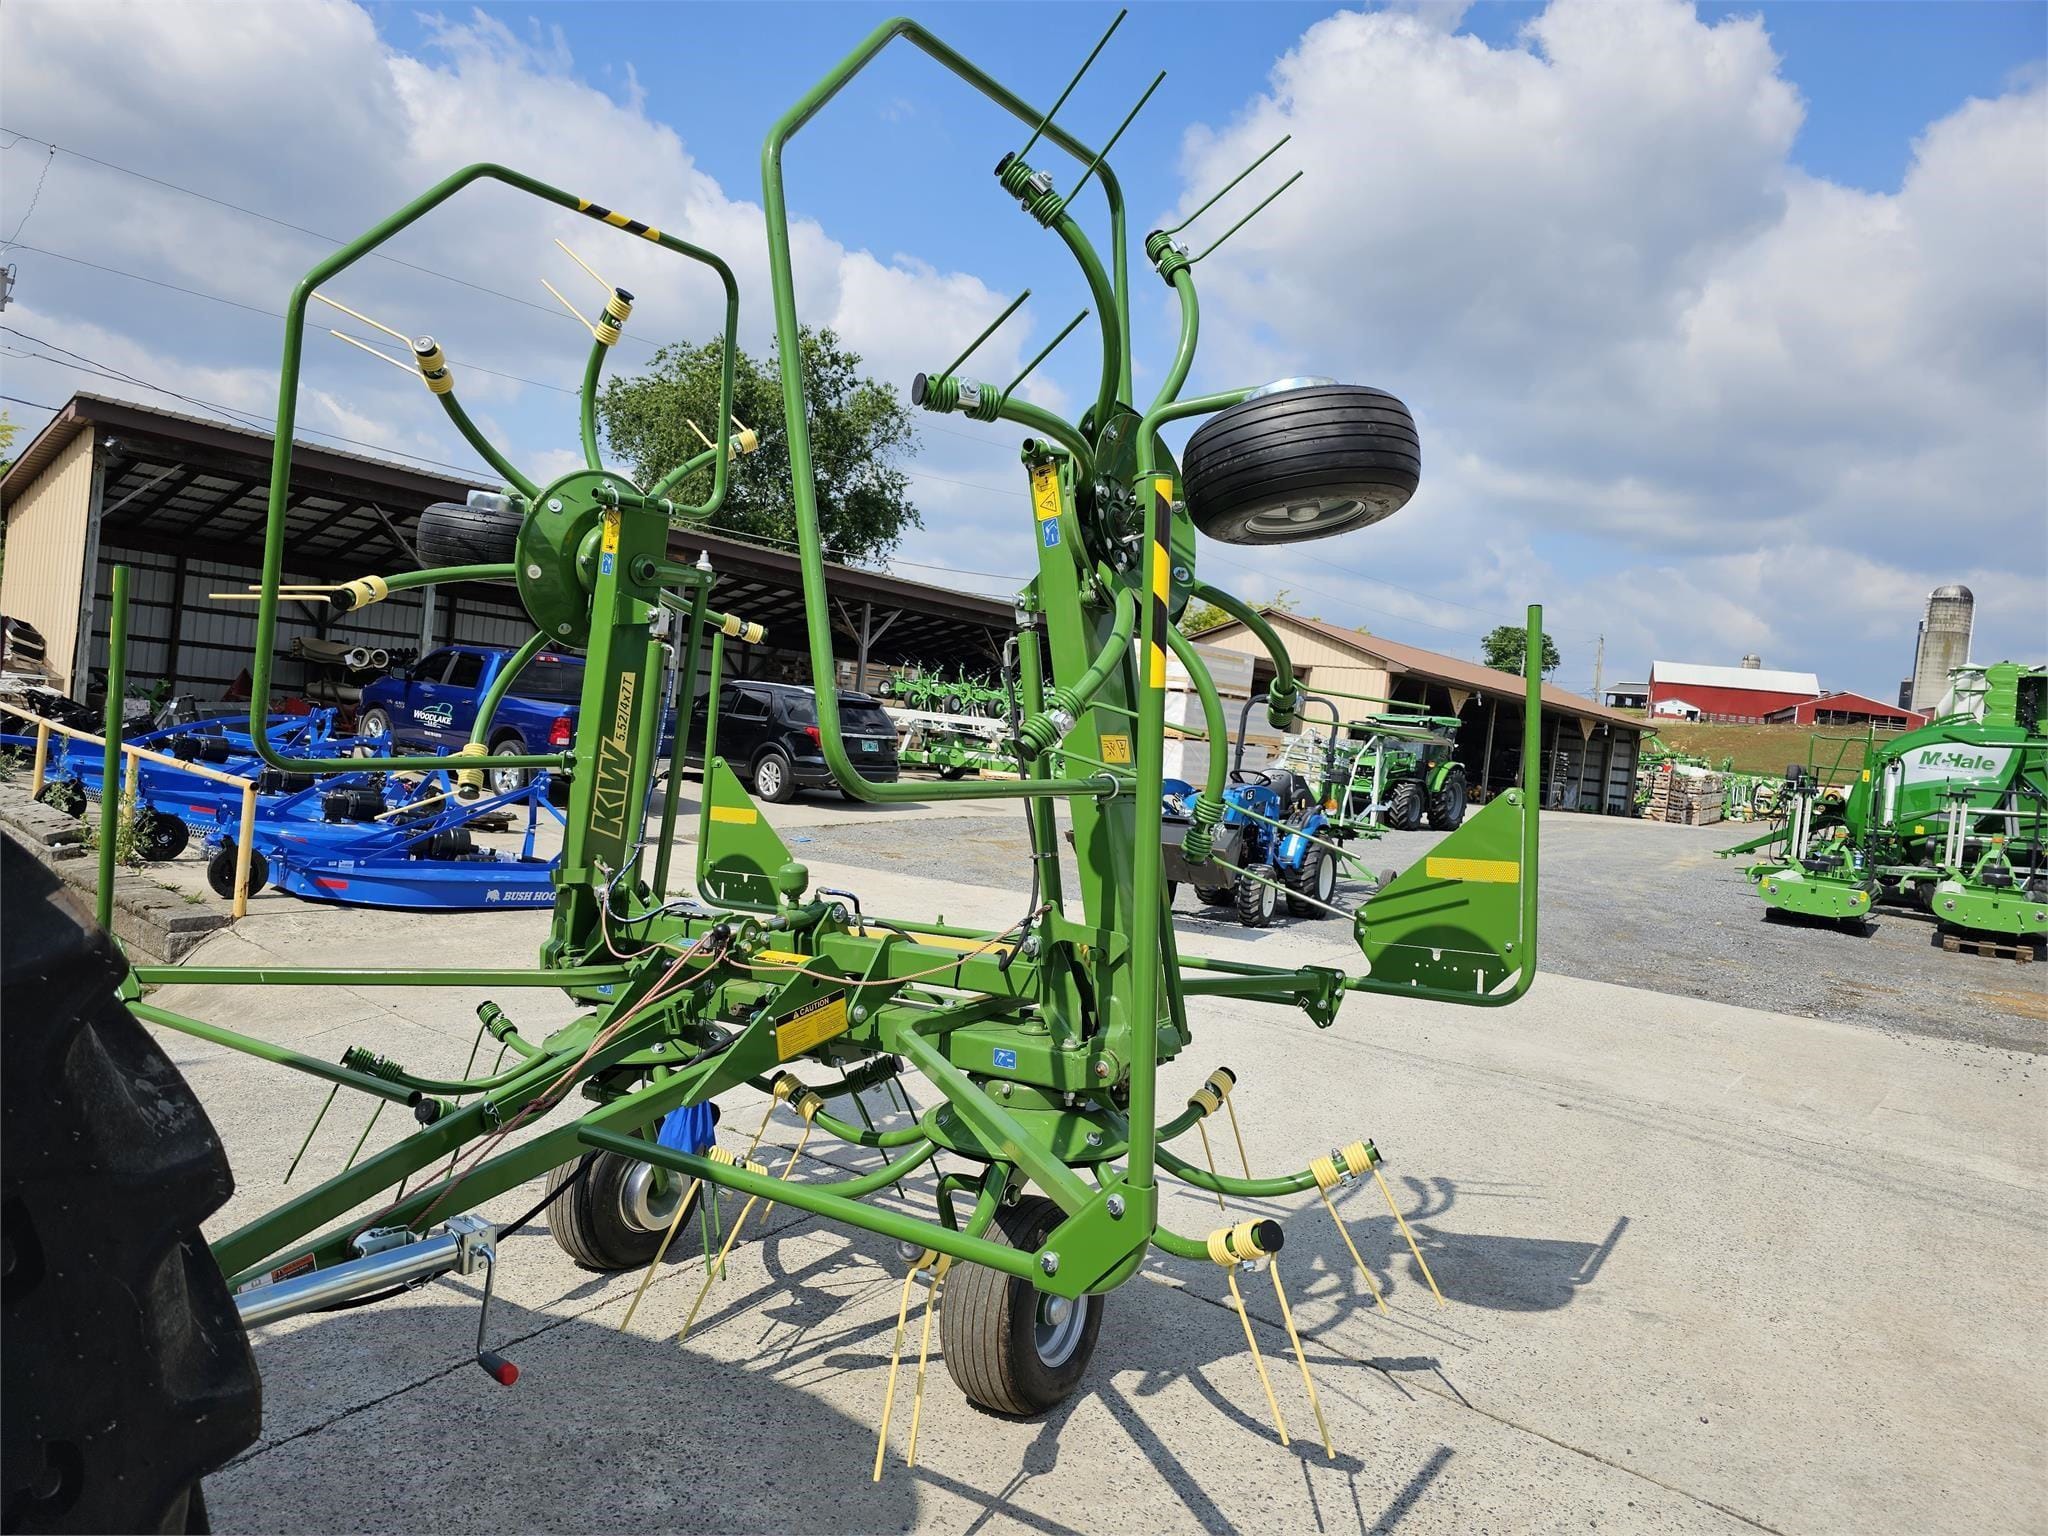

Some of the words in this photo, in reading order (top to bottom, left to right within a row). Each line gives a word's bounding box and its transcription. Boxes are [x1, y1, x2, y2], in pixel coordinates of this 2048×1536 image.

[413, 709, 453, 725] WOODLAKE
[616, 677, 633, 742] 5.52/4x7T
[1919, 751, 1995, 771] McHale
[591, 736, 632, 839] KW
[503, 891, 533, 901] BUSH
[533, 891, 557, 901] HOG
[800, 997, 830, 1016] CAUTION
